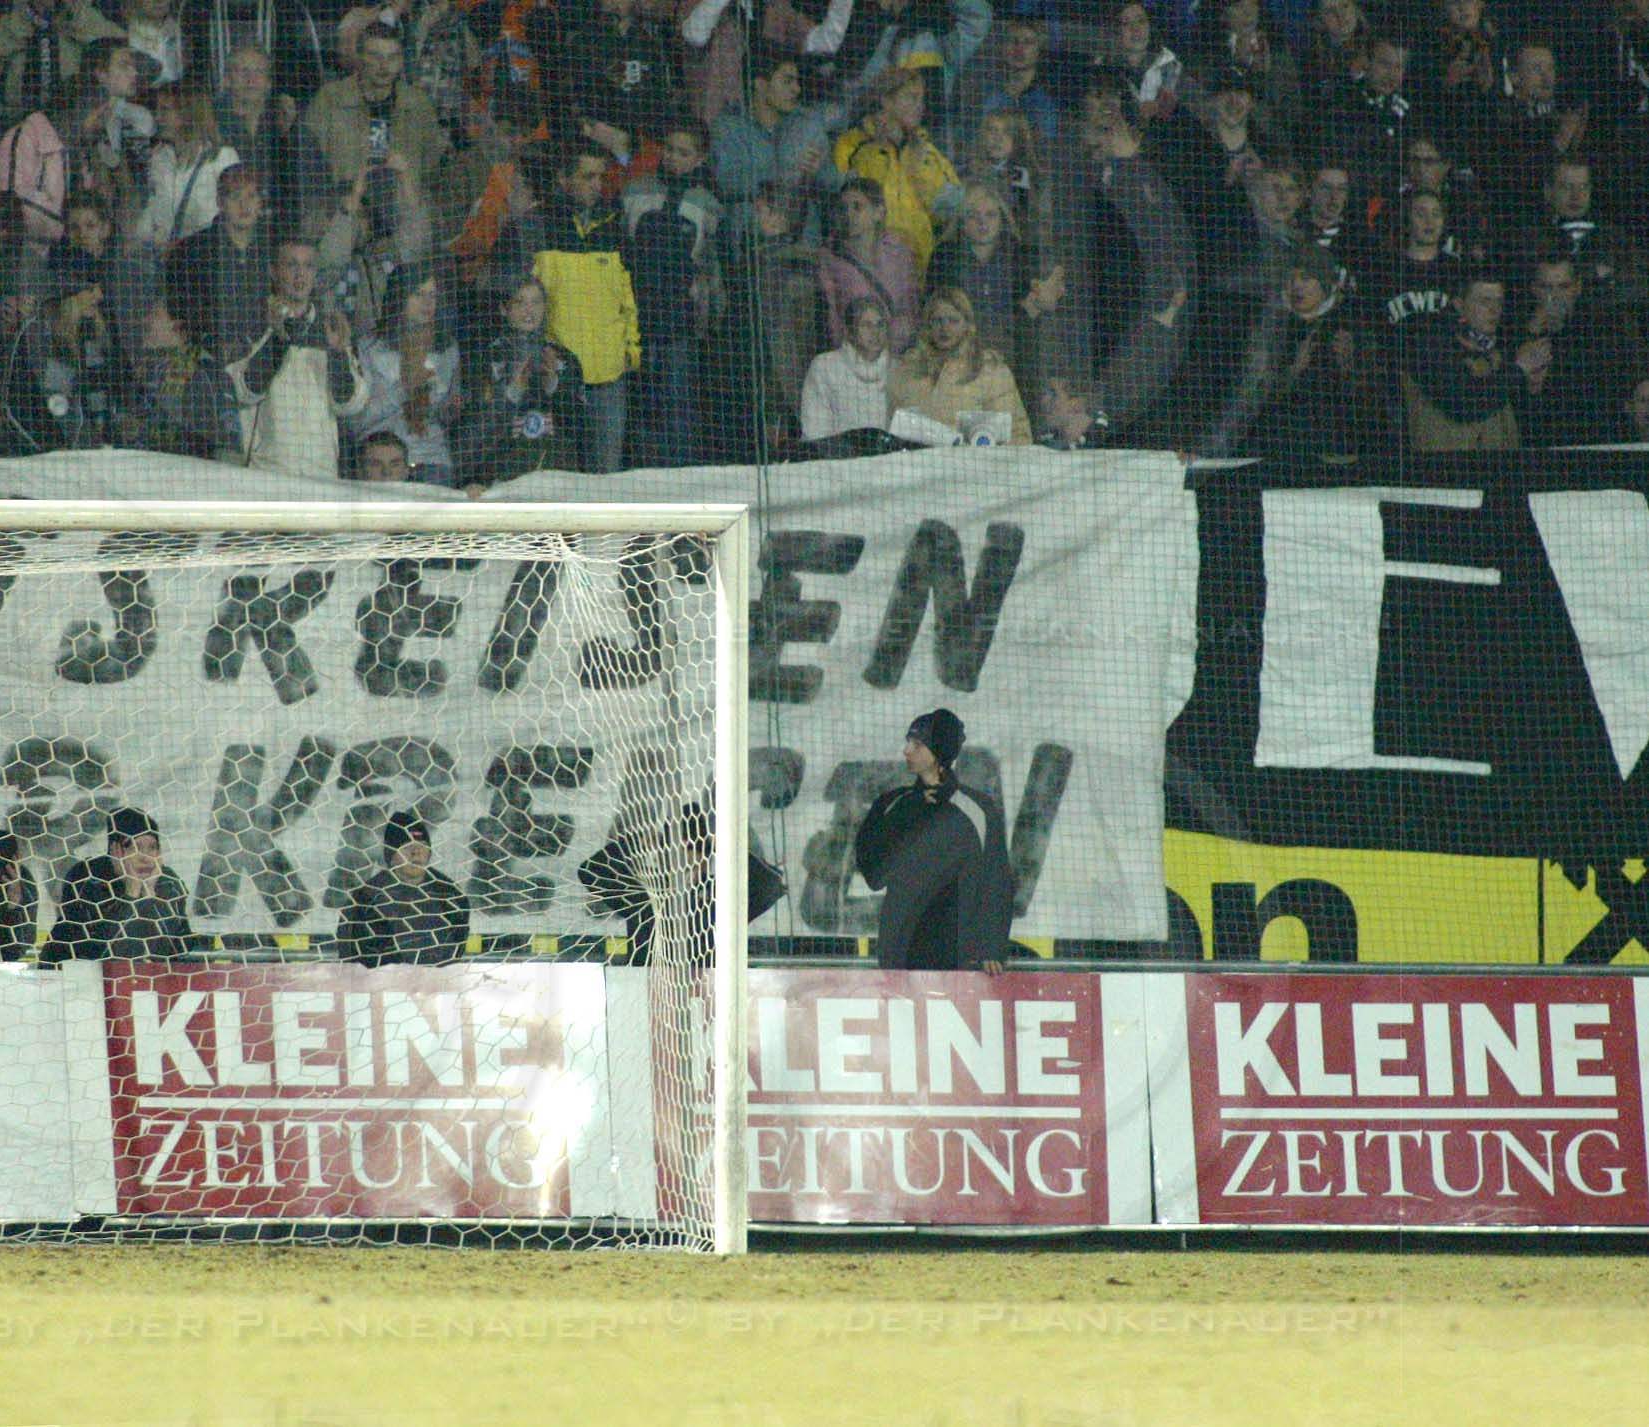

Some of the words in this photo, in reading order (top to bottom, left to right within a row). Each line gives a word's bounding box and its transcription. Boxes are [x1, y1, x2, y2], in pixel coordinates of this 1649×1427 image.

[132, 990, 529, 1088] KLEINE
[1214, 1001, 1617, 1097] KLEINE
[139, 1118, 549, 1190] ZEITUNG
[1220, 1128, 1627, 1198] ZEITUNG
